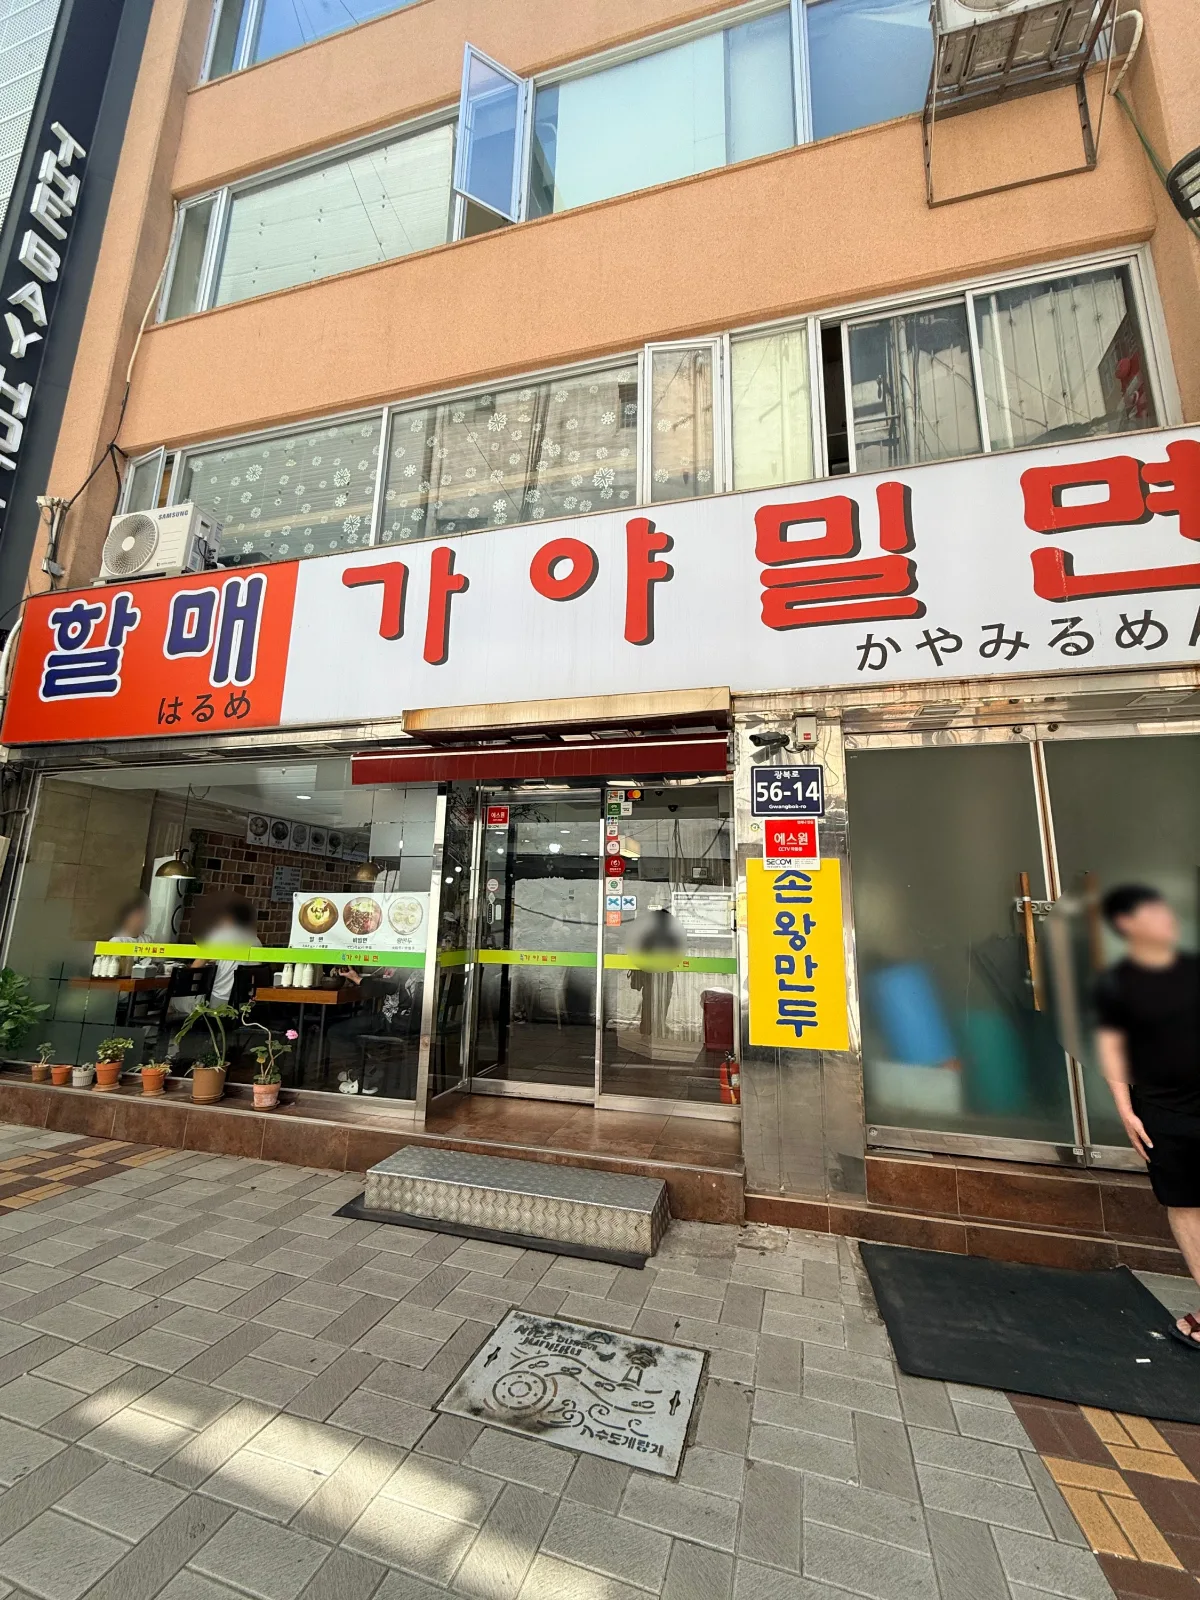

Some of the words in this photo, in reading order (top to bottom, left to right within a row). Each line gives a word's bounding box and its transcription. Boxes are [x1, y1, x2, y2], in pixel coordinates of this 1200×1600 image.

[30, 120, 87, 241] THE
[4, 228, 62, 360] BAY
[158, 510, 189, 521] SAMSUNG
[157, 690, 252, 725] はるめ
[773, 770, 801, 780] 광복로
[756, 781, 820, 803] 56-14
[768, 803, 807, 811] Gwangbok-ro
[773, 832, 809, 846] 에스원
[766, 858, 792, 866] SECOM
[772, 869, 820, 1038] 손왕만두
